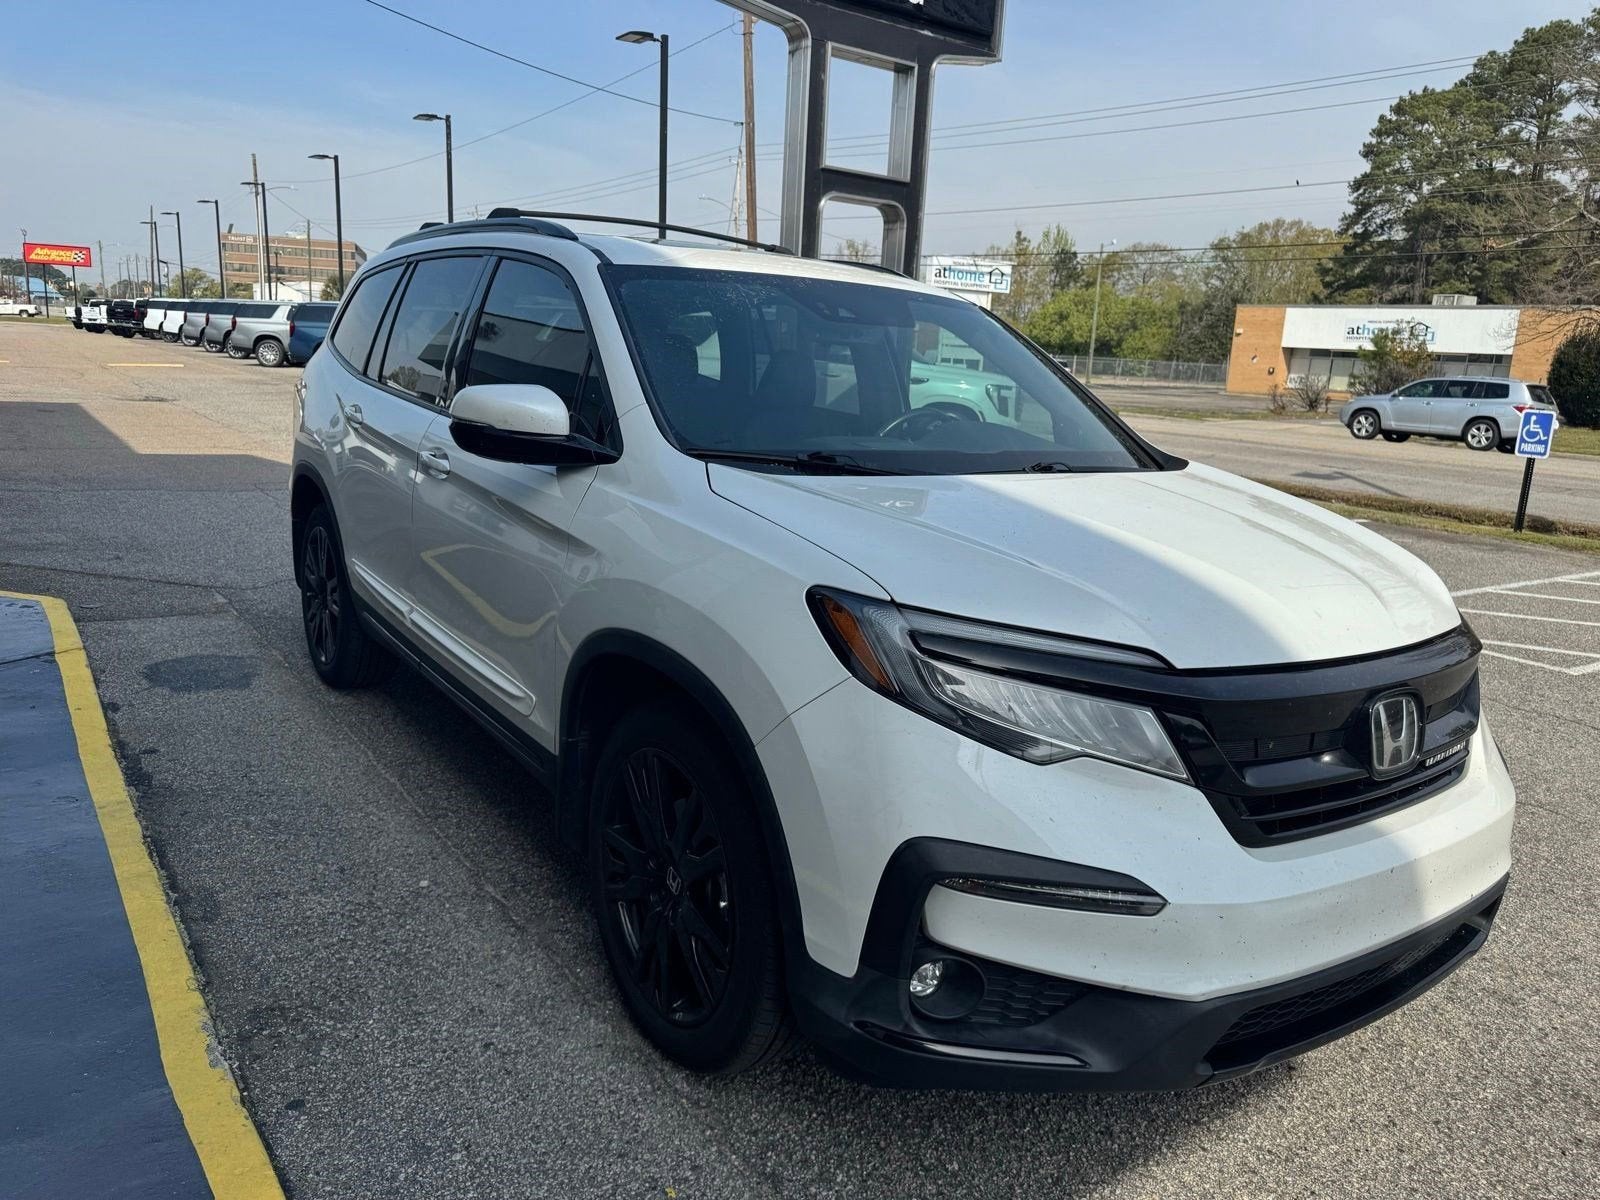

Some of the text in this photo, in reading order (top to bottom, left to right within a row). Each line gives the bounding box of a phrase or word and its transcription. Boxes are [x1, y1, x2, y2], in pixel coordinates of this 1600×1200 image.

[29, 253, 49, 261] Auto
[33, 247, 72, 257] Advance
[934, 265, 985, 282] athome
[933, 279, 991, 290] HOSPITAL EQUIPMENT
[1520, 442, 1545, 453] PARKING
